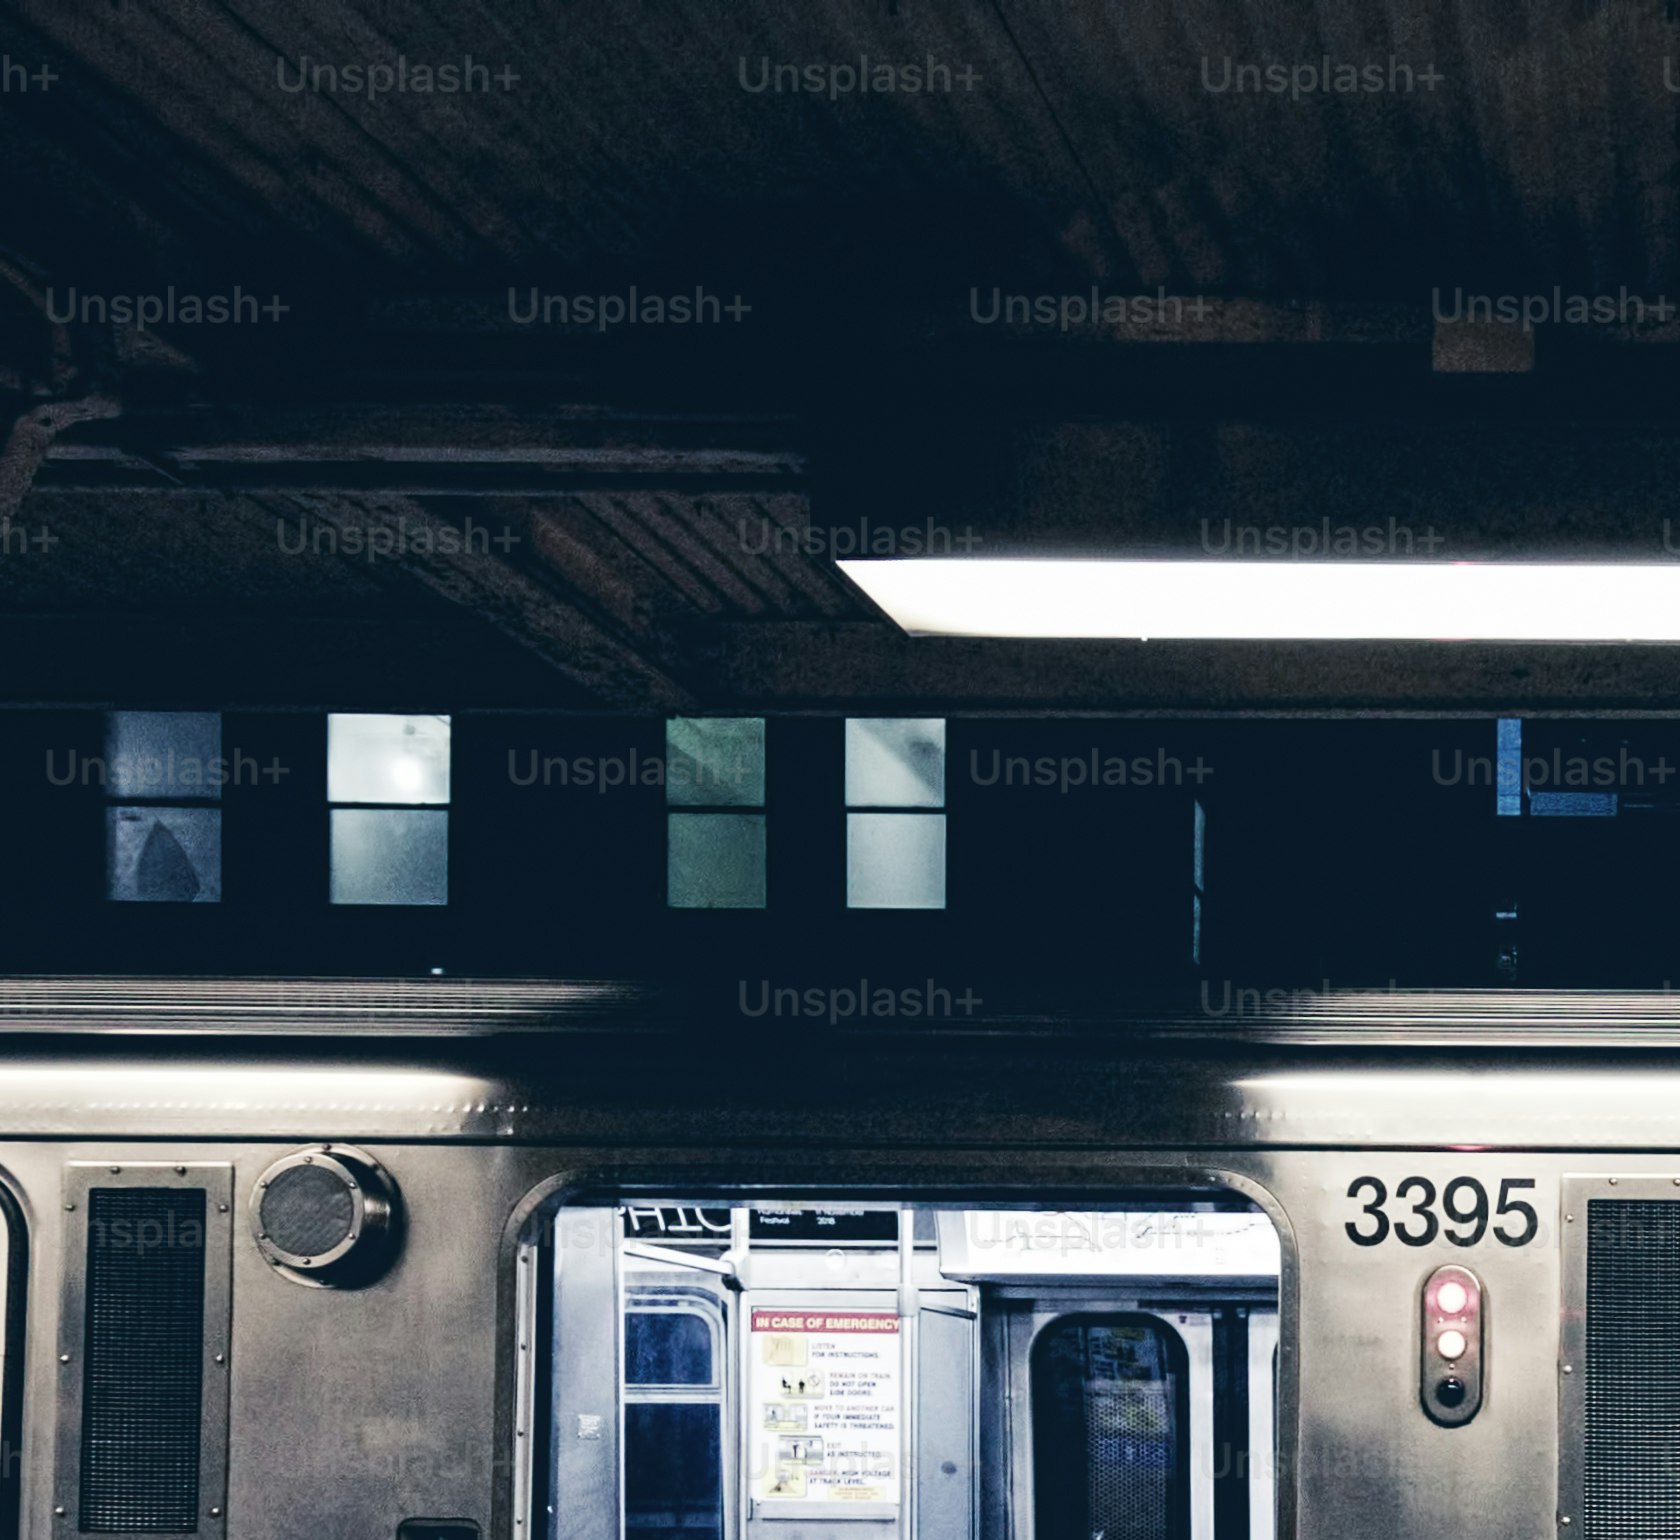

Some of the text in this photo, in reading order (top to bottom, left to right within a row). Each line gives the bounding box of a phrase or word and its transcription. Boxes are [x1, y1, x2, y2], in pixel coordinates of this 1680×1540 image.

[1345, 1175, 1539, 1247] 3395
[759, 1216, 790, 1224] Festival
[816, 1217, 836, 1225] 2018
[756, 1317, 899, 1330] IN CASE OF EMERGENCY
